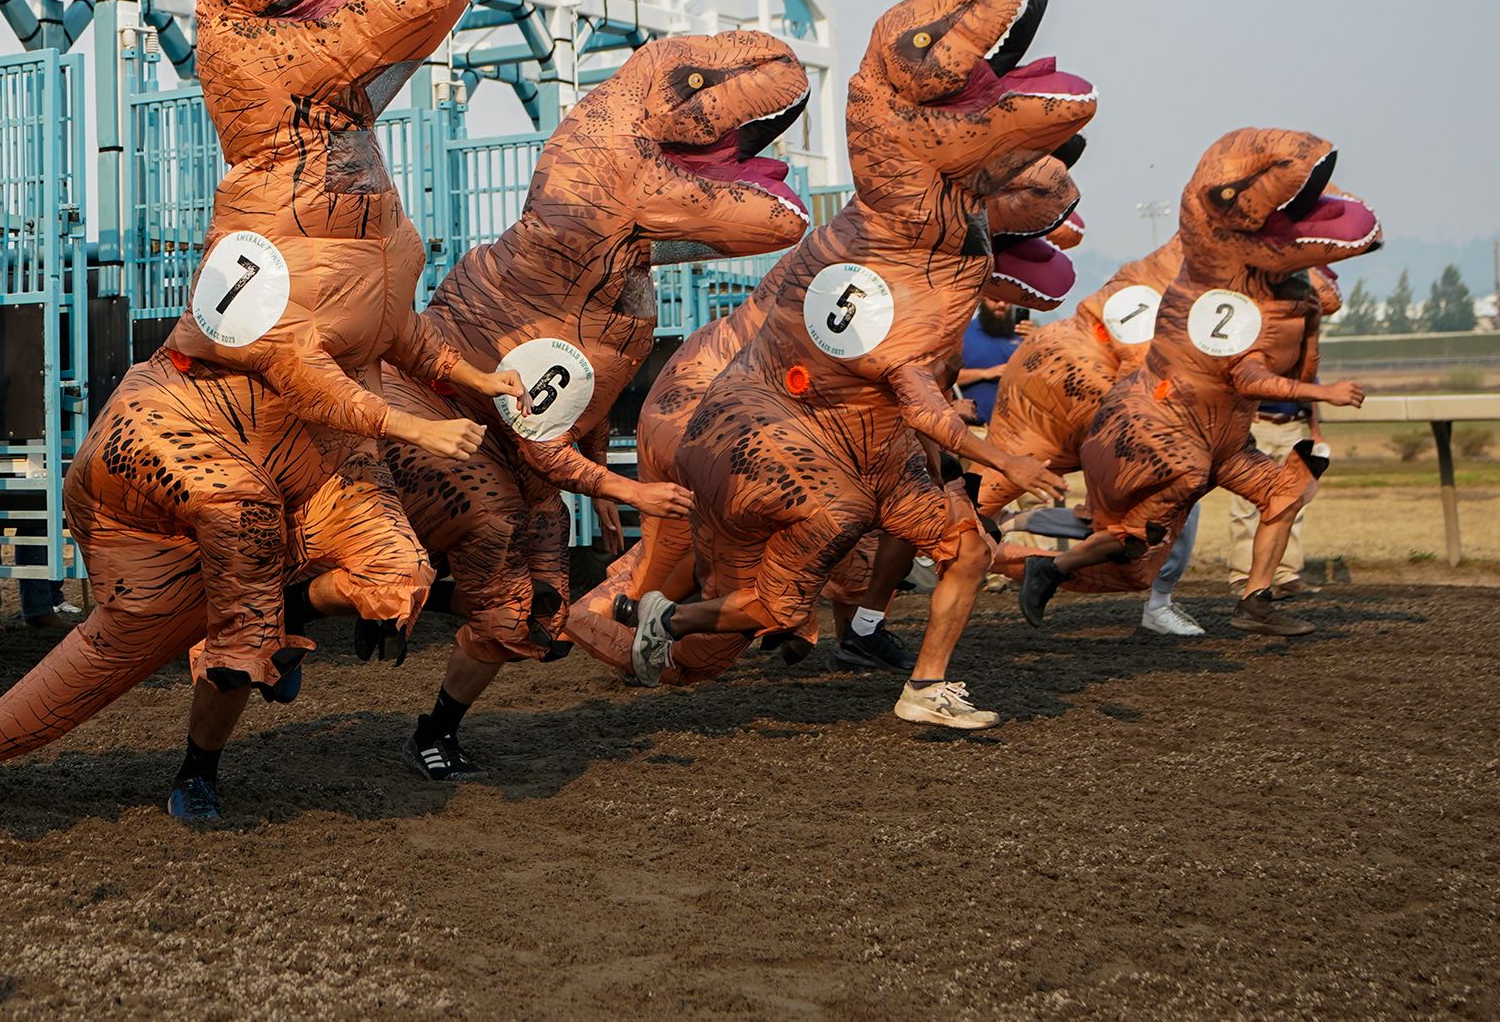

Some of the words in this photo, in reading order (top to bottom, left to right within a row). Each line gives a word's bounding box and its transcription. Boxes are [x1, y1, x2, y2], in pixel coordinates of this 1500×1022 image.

[215, 254, 261, 315] 7
[826, 282, 868, 334] 5
[1119, 302, 1150, 325] 1
[1210, 303, 1235, 340] 2
[528, 364, 571, 416] 6
